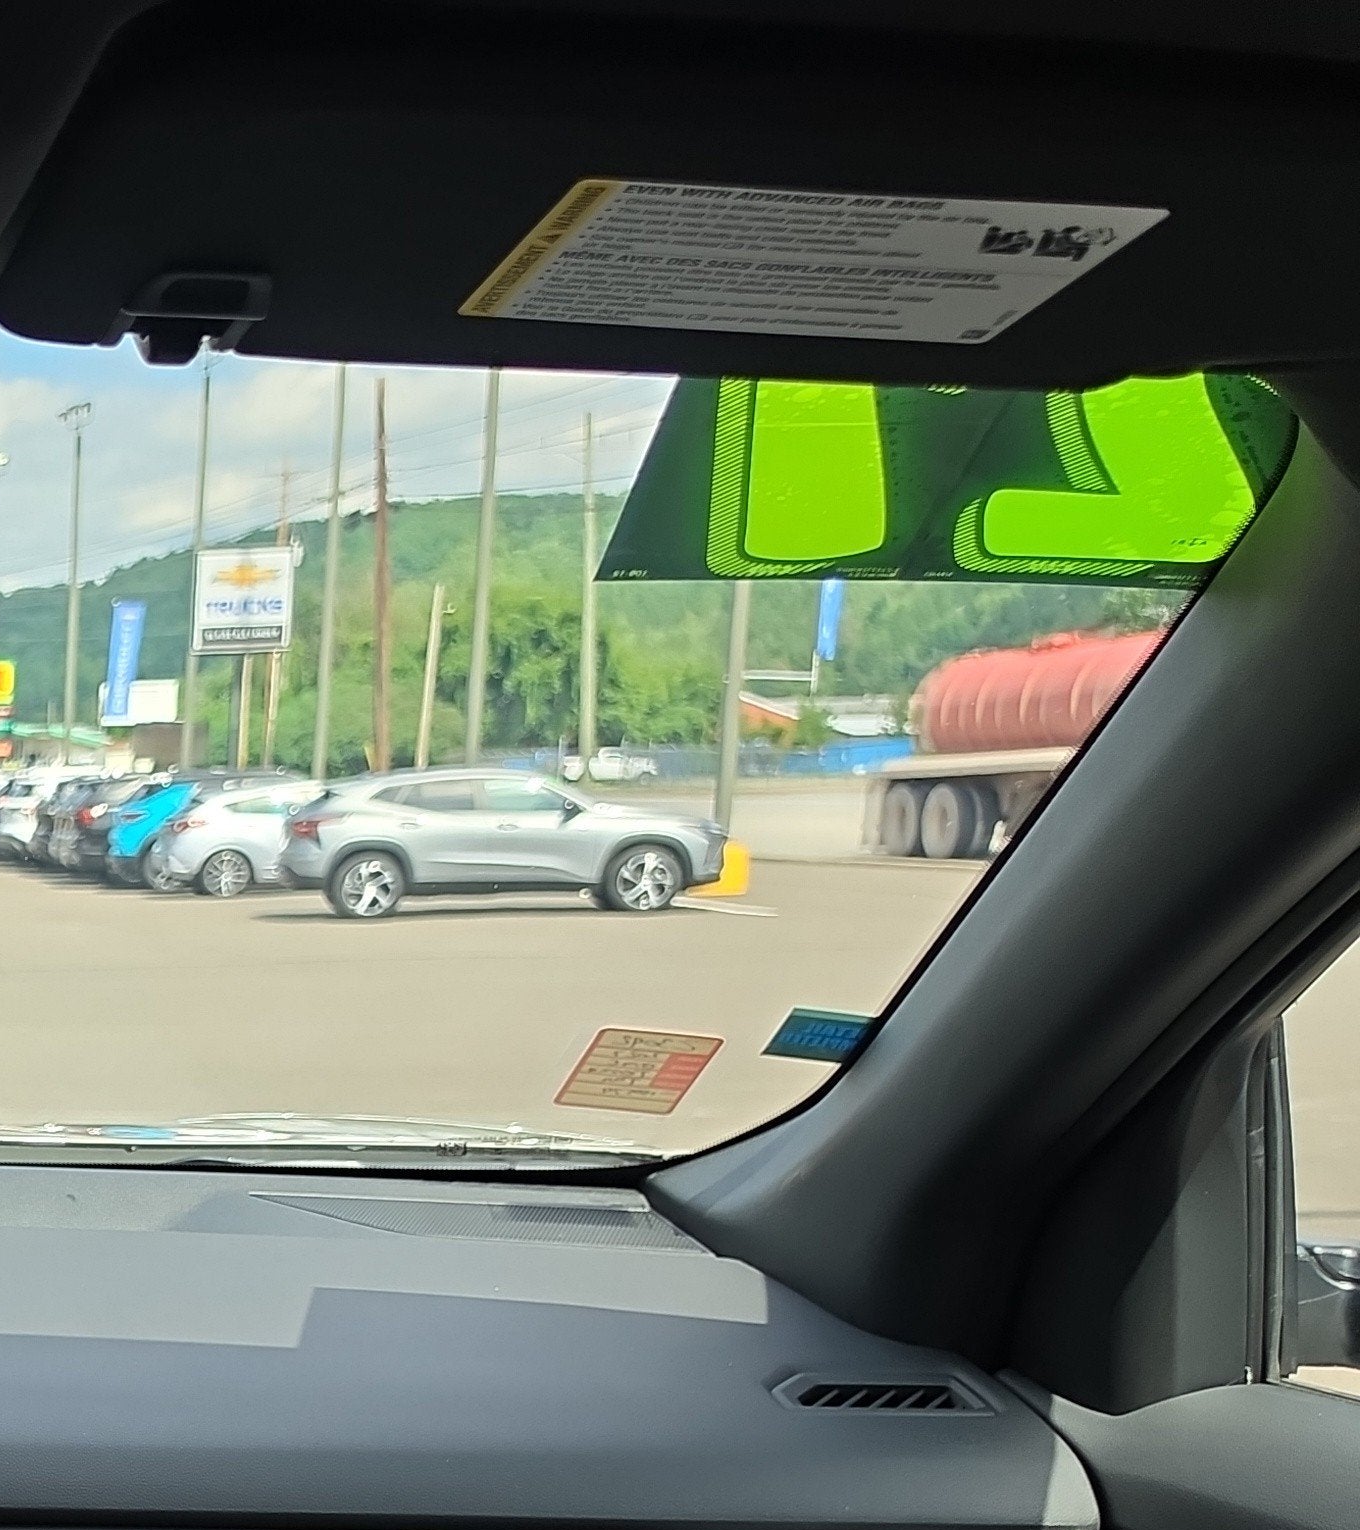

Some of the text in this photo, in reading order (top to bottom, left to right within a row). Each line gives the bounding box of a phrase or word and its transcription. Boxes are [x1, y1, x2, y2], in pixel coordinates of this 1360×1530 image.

[623, 185, 677, 196] EVEN
[681, 187, 730, 200] WITH
[737, 192, 844, 206] ADVANCED
[847, 197, 884, 208] AIR
